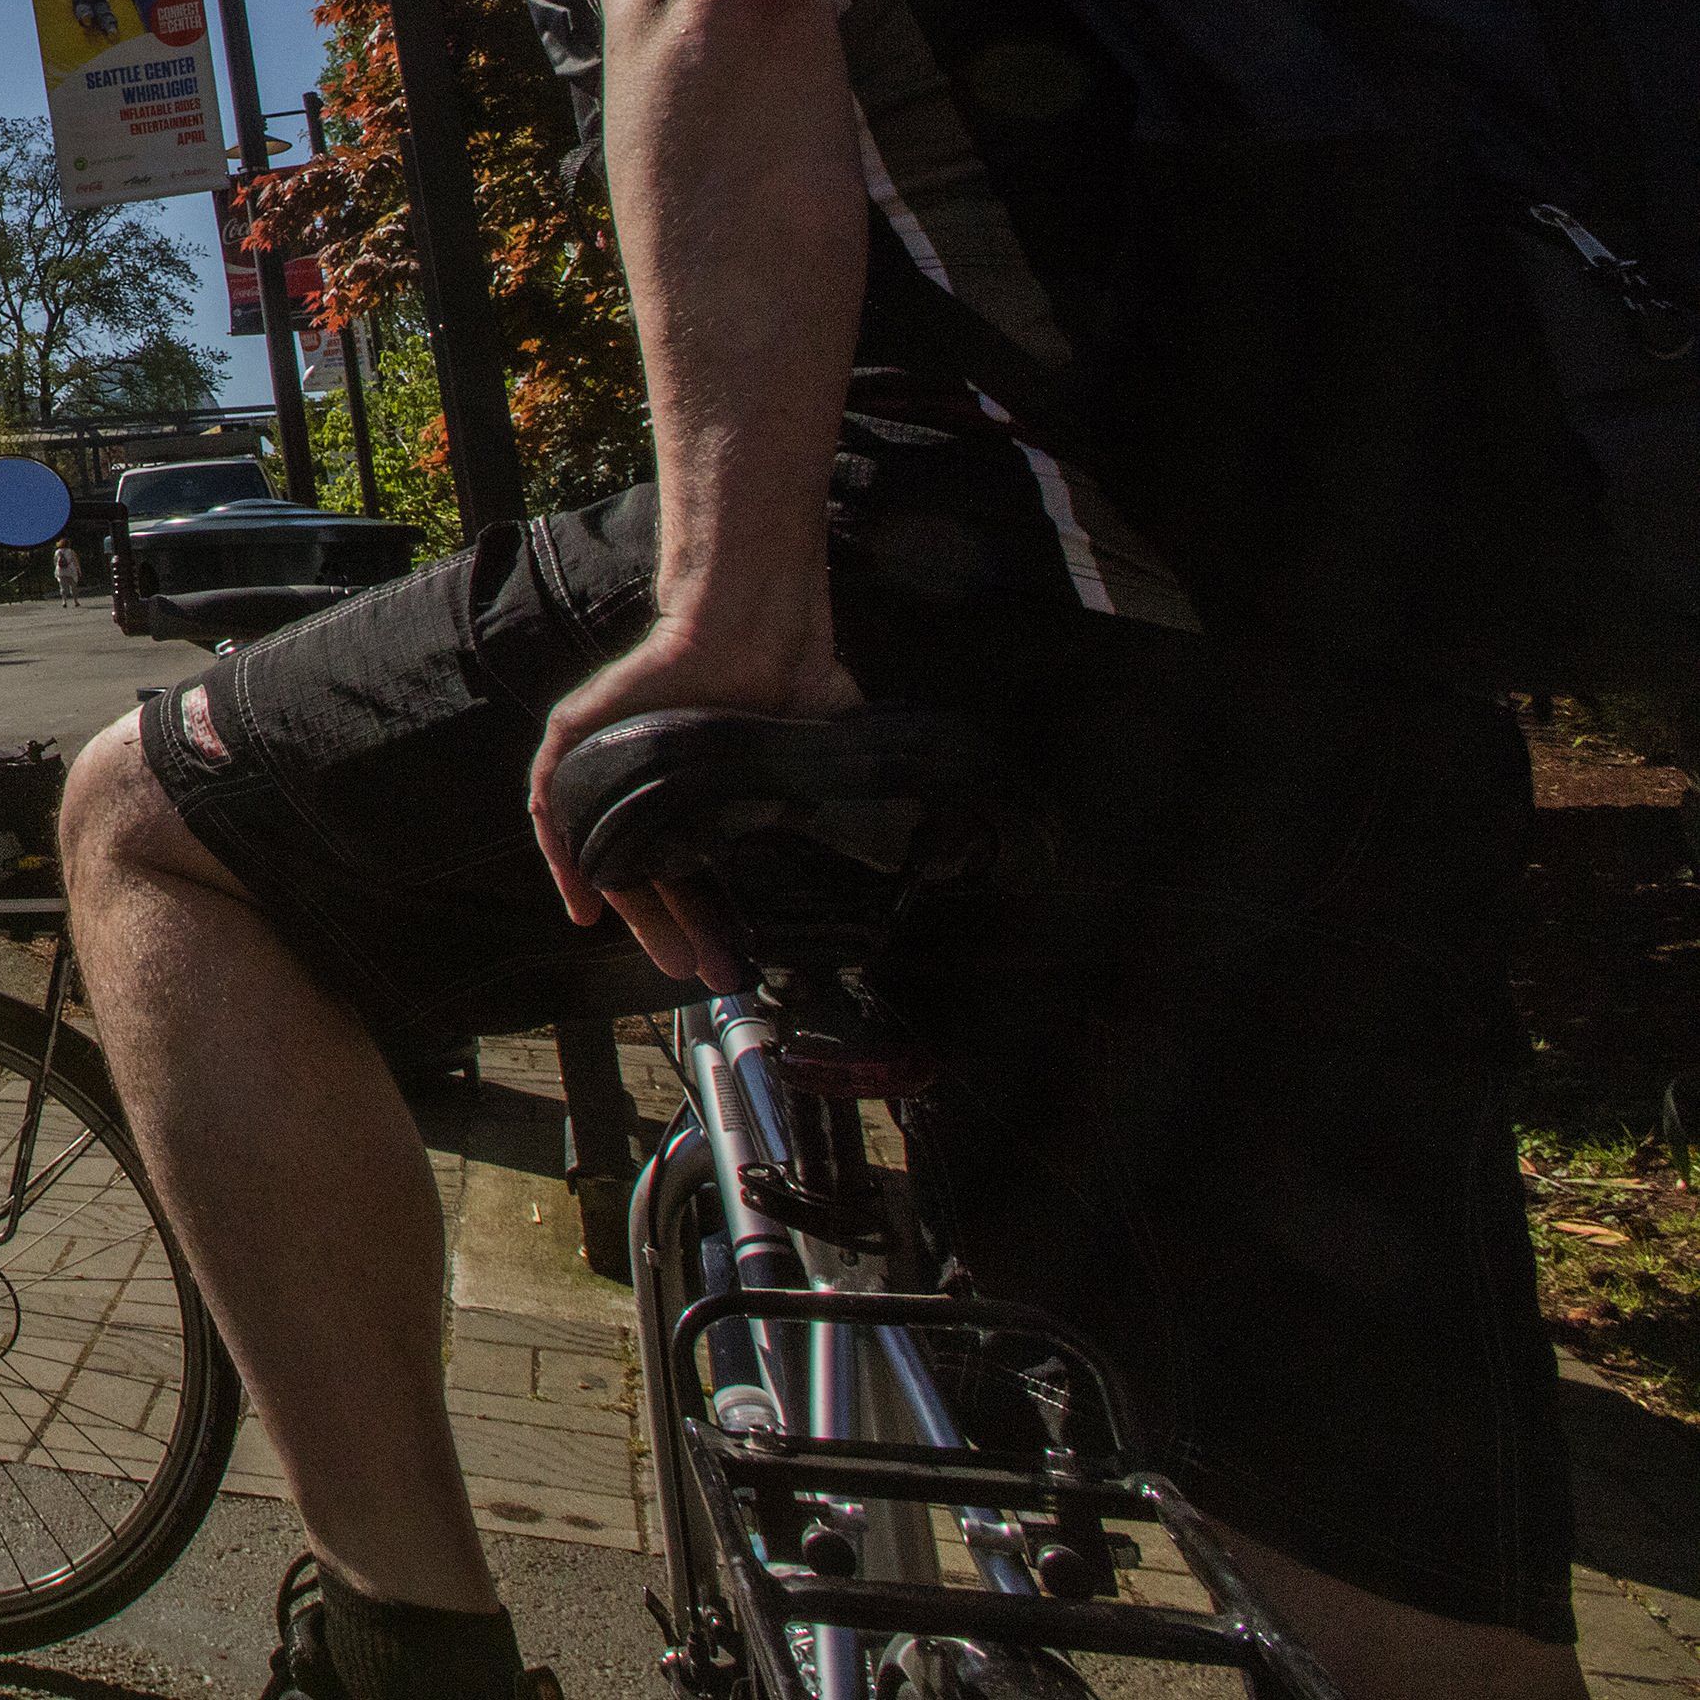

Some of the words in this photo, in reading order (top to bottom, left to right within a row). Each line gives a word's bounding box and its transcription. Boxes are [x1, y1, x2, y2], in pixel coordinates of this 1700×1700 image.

[157, 1, 199, 21] CONNECT
[167, 14, 202, 33] CENTER
[85, 65, 141, 90] SEATTLE
[144, 56, 196, 80] CENTER
[121, 77, 199, 104] WHIRLIGIG!
[119, 102, 172, 121] INFLATABLE
[174, 98, 201, 113] RIDES
[130, 113, 204, 136] ENTERTAINMENT
[177, 130, 207, 146] APRIL
